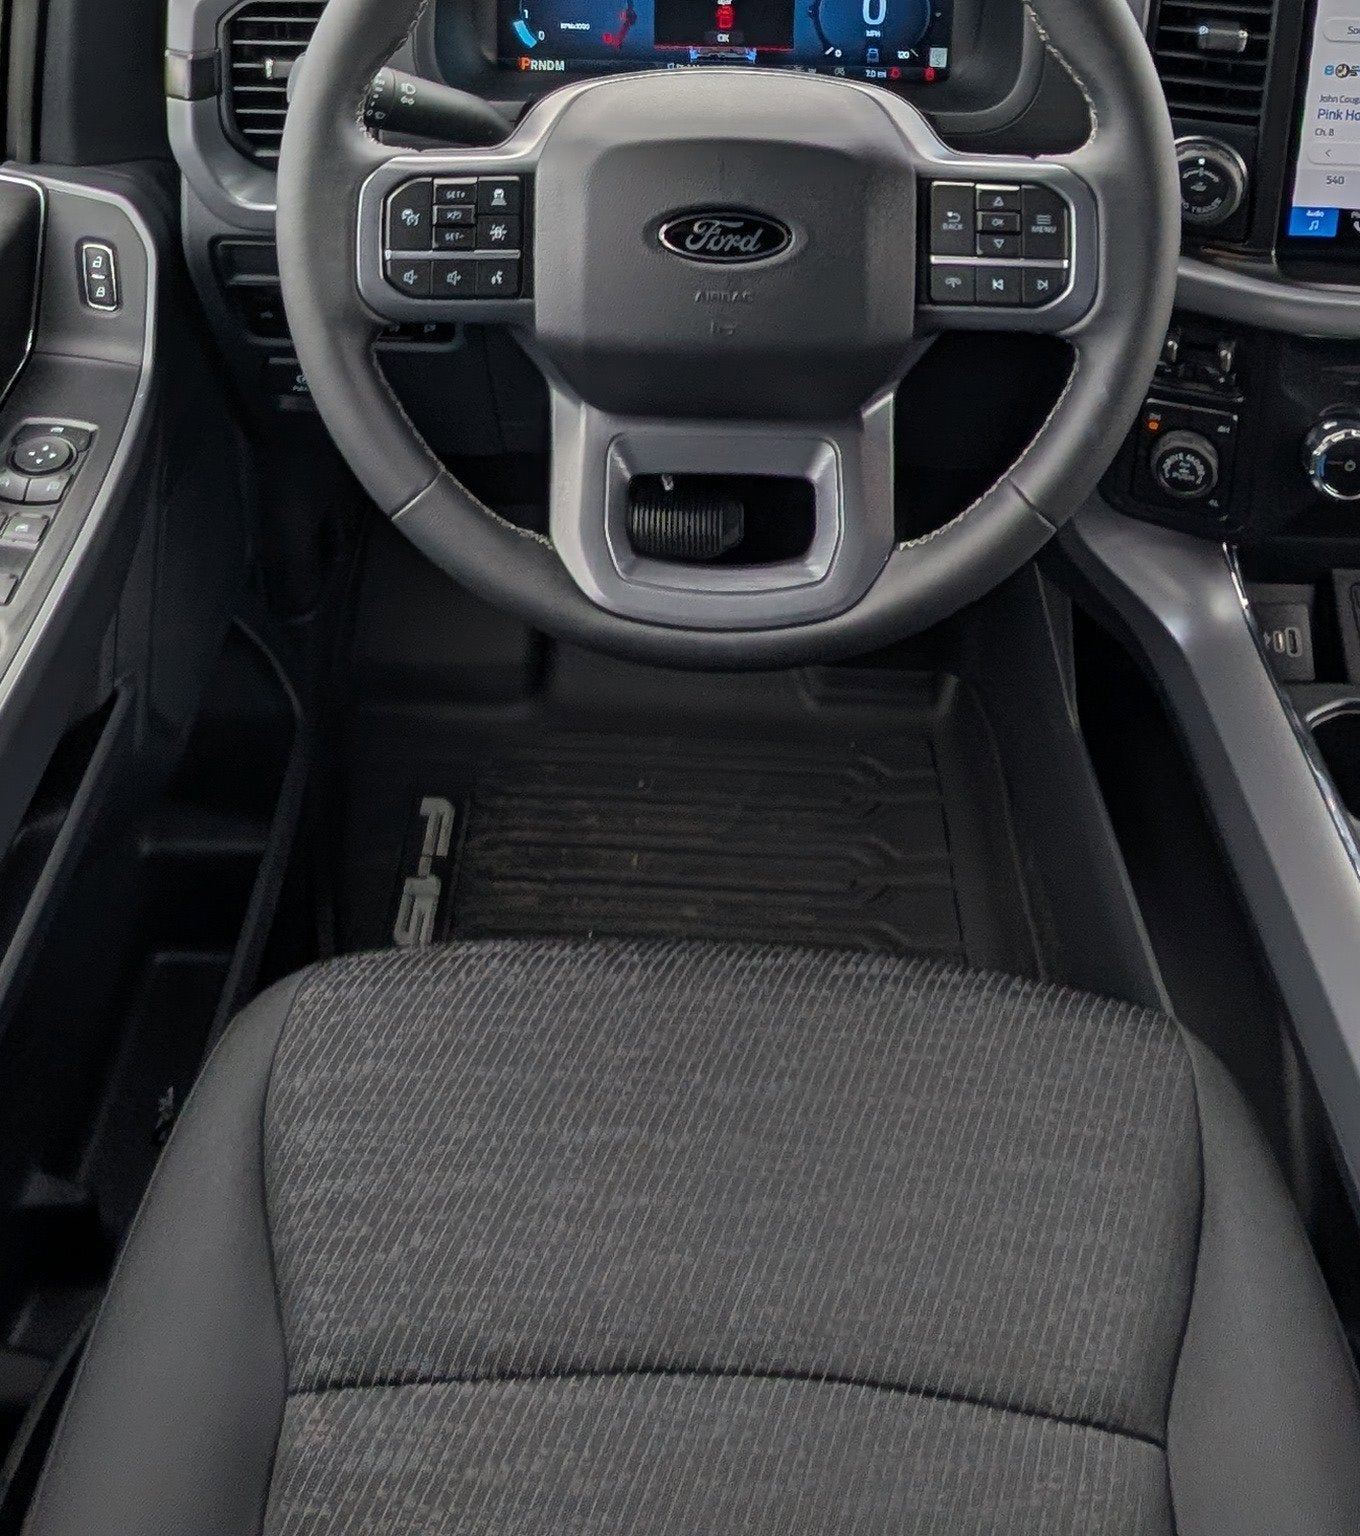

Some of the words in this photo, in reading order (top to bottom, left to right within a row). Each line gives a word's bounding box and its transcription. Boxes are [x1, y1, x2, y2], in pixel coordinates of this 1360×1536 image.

[523, 9, 529, 19] 1
[538, 30, 545, 41] 0
[716, 33, 730, 43] OK
[1319, 94, 1339, 104] John
[1317, 108, 1343, 121] Pink
[1326, 175, 1345, 186] 540
[1305, 209, 1325, 218] Audio
[1031, 224, 1058, 234] MENU
[684, 218, 767, 253] Ford
